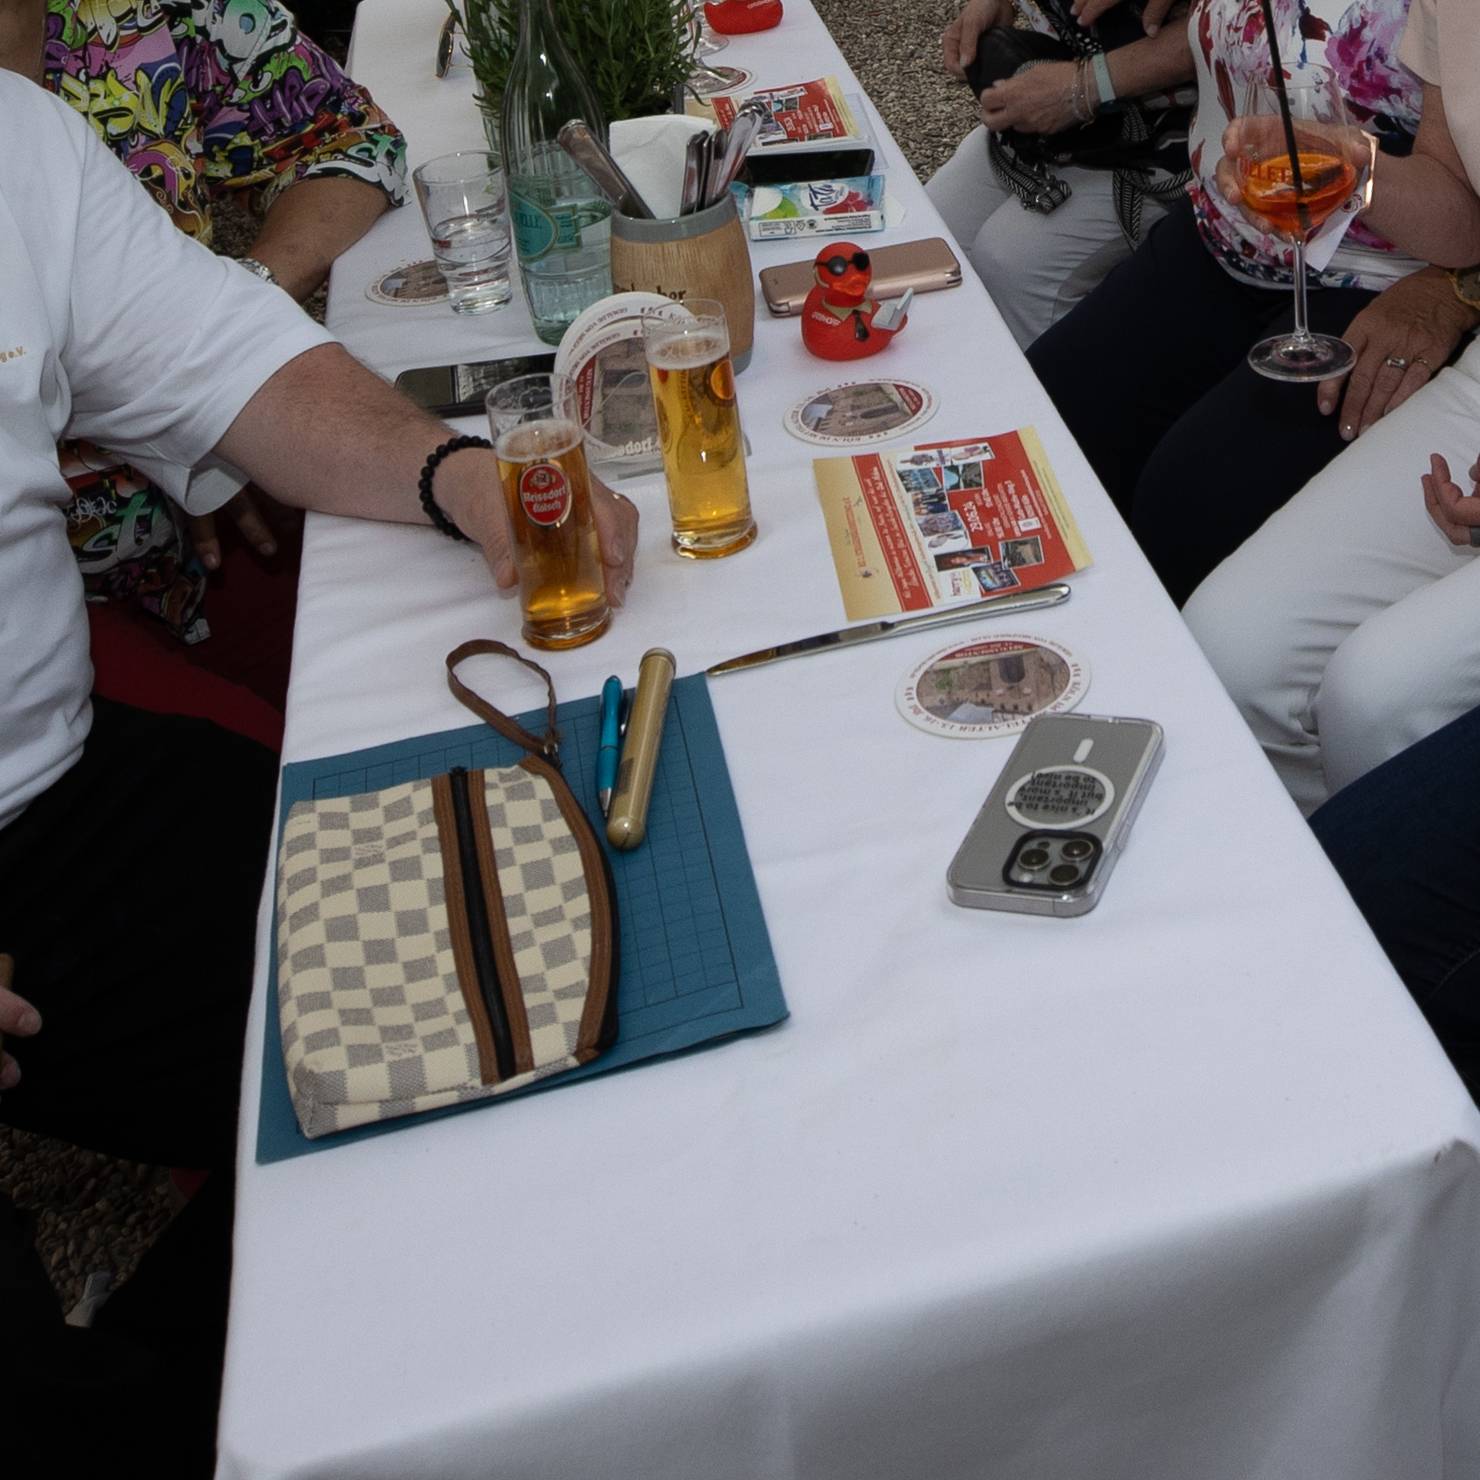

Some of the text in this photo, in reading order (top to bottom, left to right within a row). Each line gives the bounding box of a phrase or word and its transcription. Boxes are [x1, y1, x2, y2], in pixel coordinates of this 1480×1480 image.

[1020, 785, 1051, 796] more
[1081, 791, 1103, 801] but
[1025, 803, 1039, 812] to
[1042, 804, 1068, 814] nice
